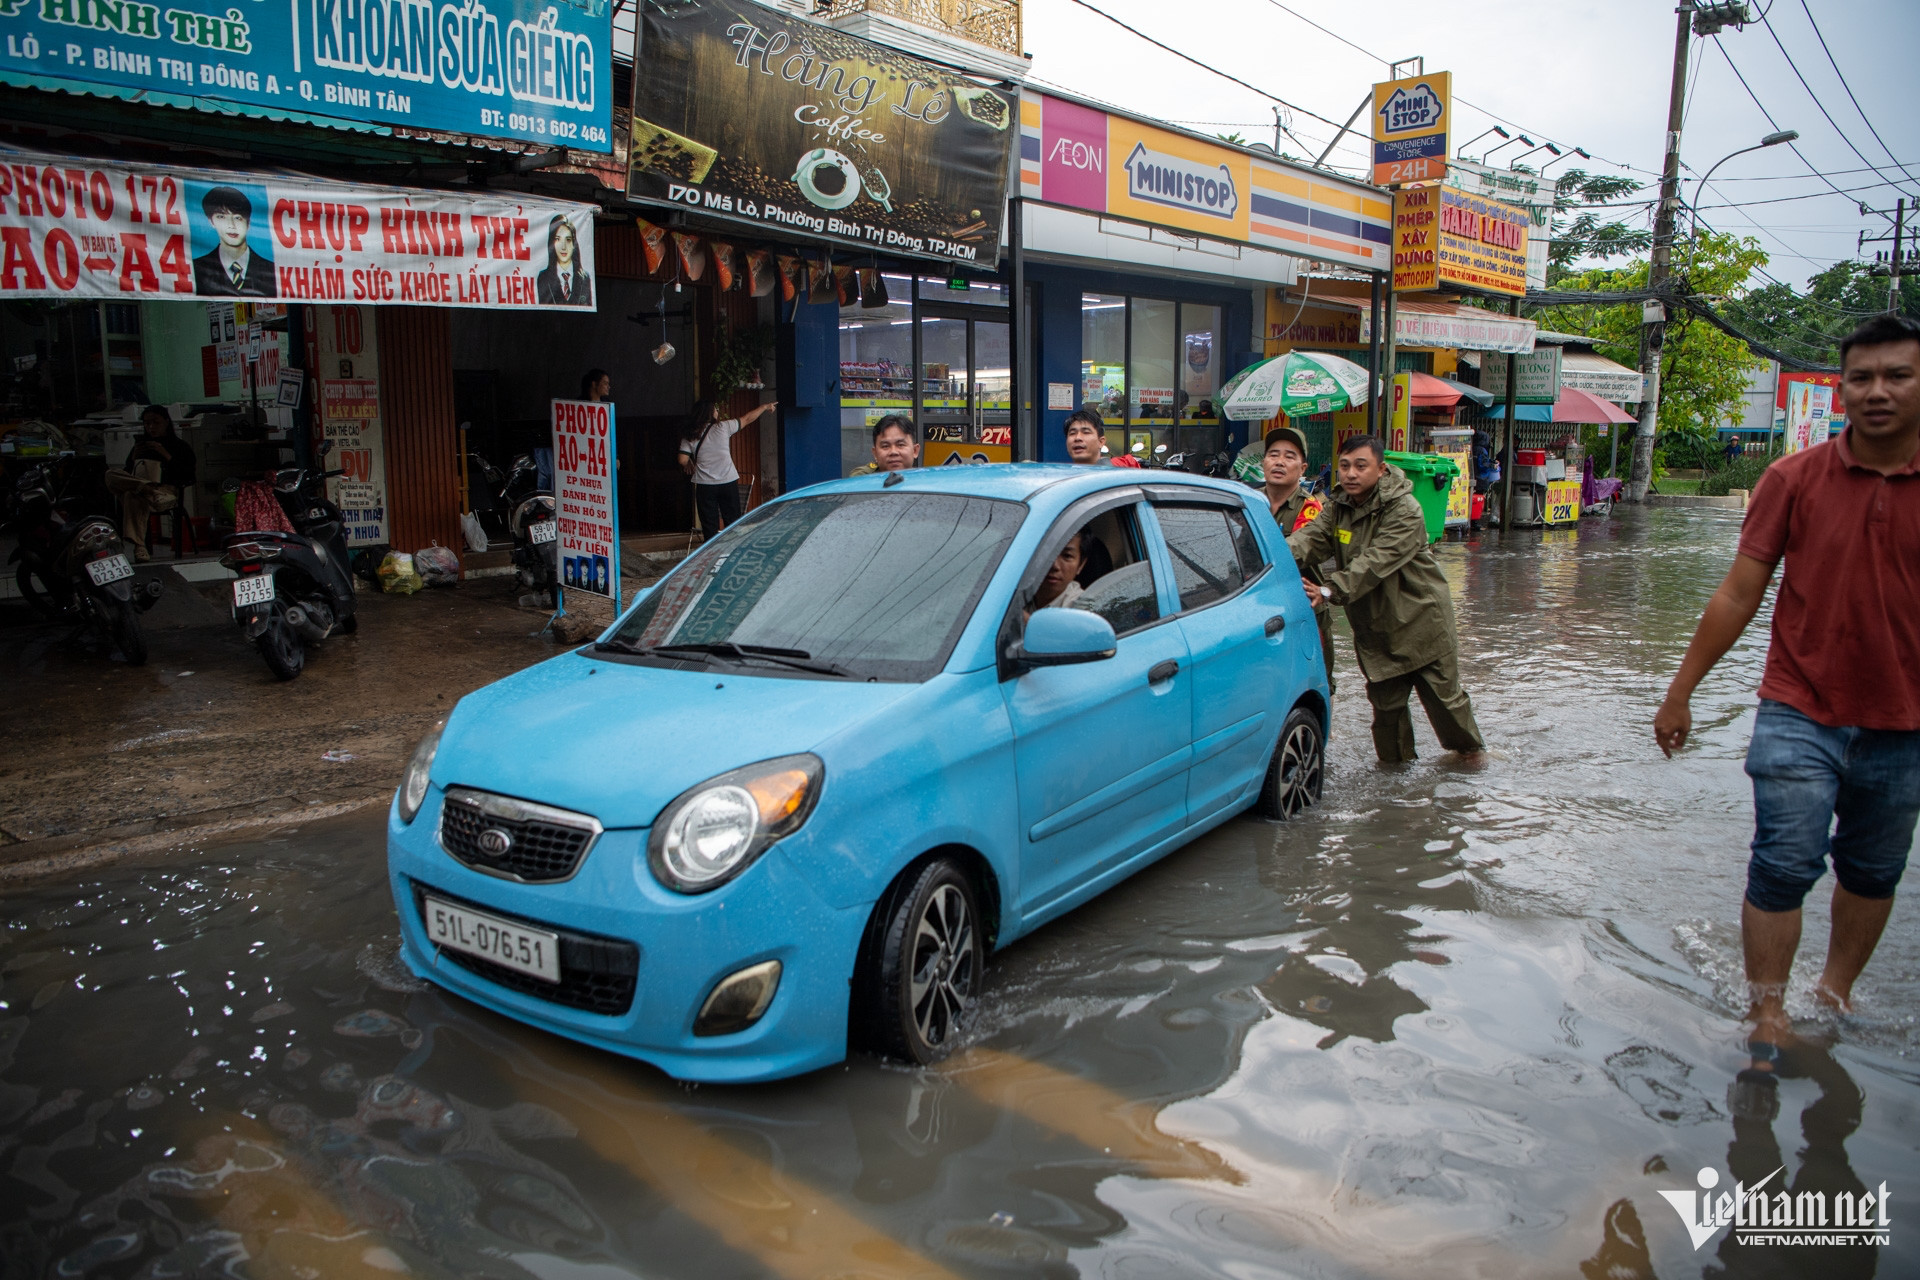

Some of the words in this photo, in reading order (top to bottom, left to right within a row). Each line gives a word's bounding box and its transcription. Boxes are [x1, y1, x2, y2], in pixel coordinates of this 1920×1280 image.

[166, 8, 251, 54] THẺ
[507, 7, 595, 112] GIẾNG
[7, 32, 40, 60] LÒ
[66, 44, 87, 66] P.
[93, 46, 152, 76] BÌNH
[157, 57, 194, 87] TRỊ
[200, 63, 260, 92] ĐÔNG
[266, 75, 281, 95] A
[300, 80, 319, 101] Q.
[325, 82, 371, 109] BÌNH
[375, 90, 411, 114] TÂN
[726, 23, 887, 115] Hằng
[890, 80, 950, 125] Lê
[1394, 95, 1429, 114] MINI
[480, 108, 505, 129] ĐT:
[509, 112, 546, 134] 0913
[549, 119, 577, 140] 602
[581, 123, 607, 144] 464
[794, 104, 888, 144] Coffee
[1392, 108, 1431, 127] STOP
[1384, 136, 1437, 152] CONVENIENCE
[1397, 147, 1423, 160] STORE
[1390, 160, 1429, 182] 24H
[1136, 160, 1231, 210] MINISTOP
[125, 173, 183, 225] 172
[1404, 192, 1429, 207] XIN
[667, 183, 702, 205] 170
[704, 191, 733, 212] Mã
[737, 198, 761, 219] Lò,
[764, 204, 825, 233] Phường
[828, 217, 862, 239] Bình
[864, 224, 885, 246] Trị
[886, 231, 925, 252] Đông,
[927, 237, 978, 261] TP.HCM
[1396, 208, 1436, 228] PHÉP
[272, 197, 370, 264] CHỤP
[380, 196, 465, 258] HÌNH
[470, 204, 532, 262] THẺ
[1401, 228, 1429, 247] XÂY
[1482, 216, 1523, 251] LAND
[119, 232, 194, 294] A4
[1394, 249, 1436, 270] DỰNG
[278, 260, 346, 301] KHÁM
[352, 262, 394, 302] SỨC
[400, 261, 452, 302] KHỎE
[456, 263, 491, 304] LẤY
[496, 266, 537, 305] LIỀN
[1394, 269, 1436, 288] PHOTOCOPY
[1288, 321, 1316, 341] CÔNG
[1317, 322, 1337, 342] NHÀ
[1405, 318, 1419, 334] VẼ
[1422, 320, 1448, 338] HIỆN
[555, 403, 608, 437] PHOTO
[587, 437, 607, 477] A4
[566, 473, 577, 485] ÉP
[562, 489, 587, 501] ĐÁNH
[1553, 504, 1572, 520] 22K
[558, 517, 577, 536] CHỤP
[578, 518, 598, 540] HÌNH
[599, 522, 612, 544] THẺ
[563, 536, 582, 550] LẤY
[586, 541, 609, 557] LIỀN
[95, 565, 132, 584] 023.36
[239, 577, 267, 593] 63-B1
[237, 587, 272, 605] 732.55
[482, 833, 503, 851] KIA
[435, 908, 544, 969] 51L-076.51
